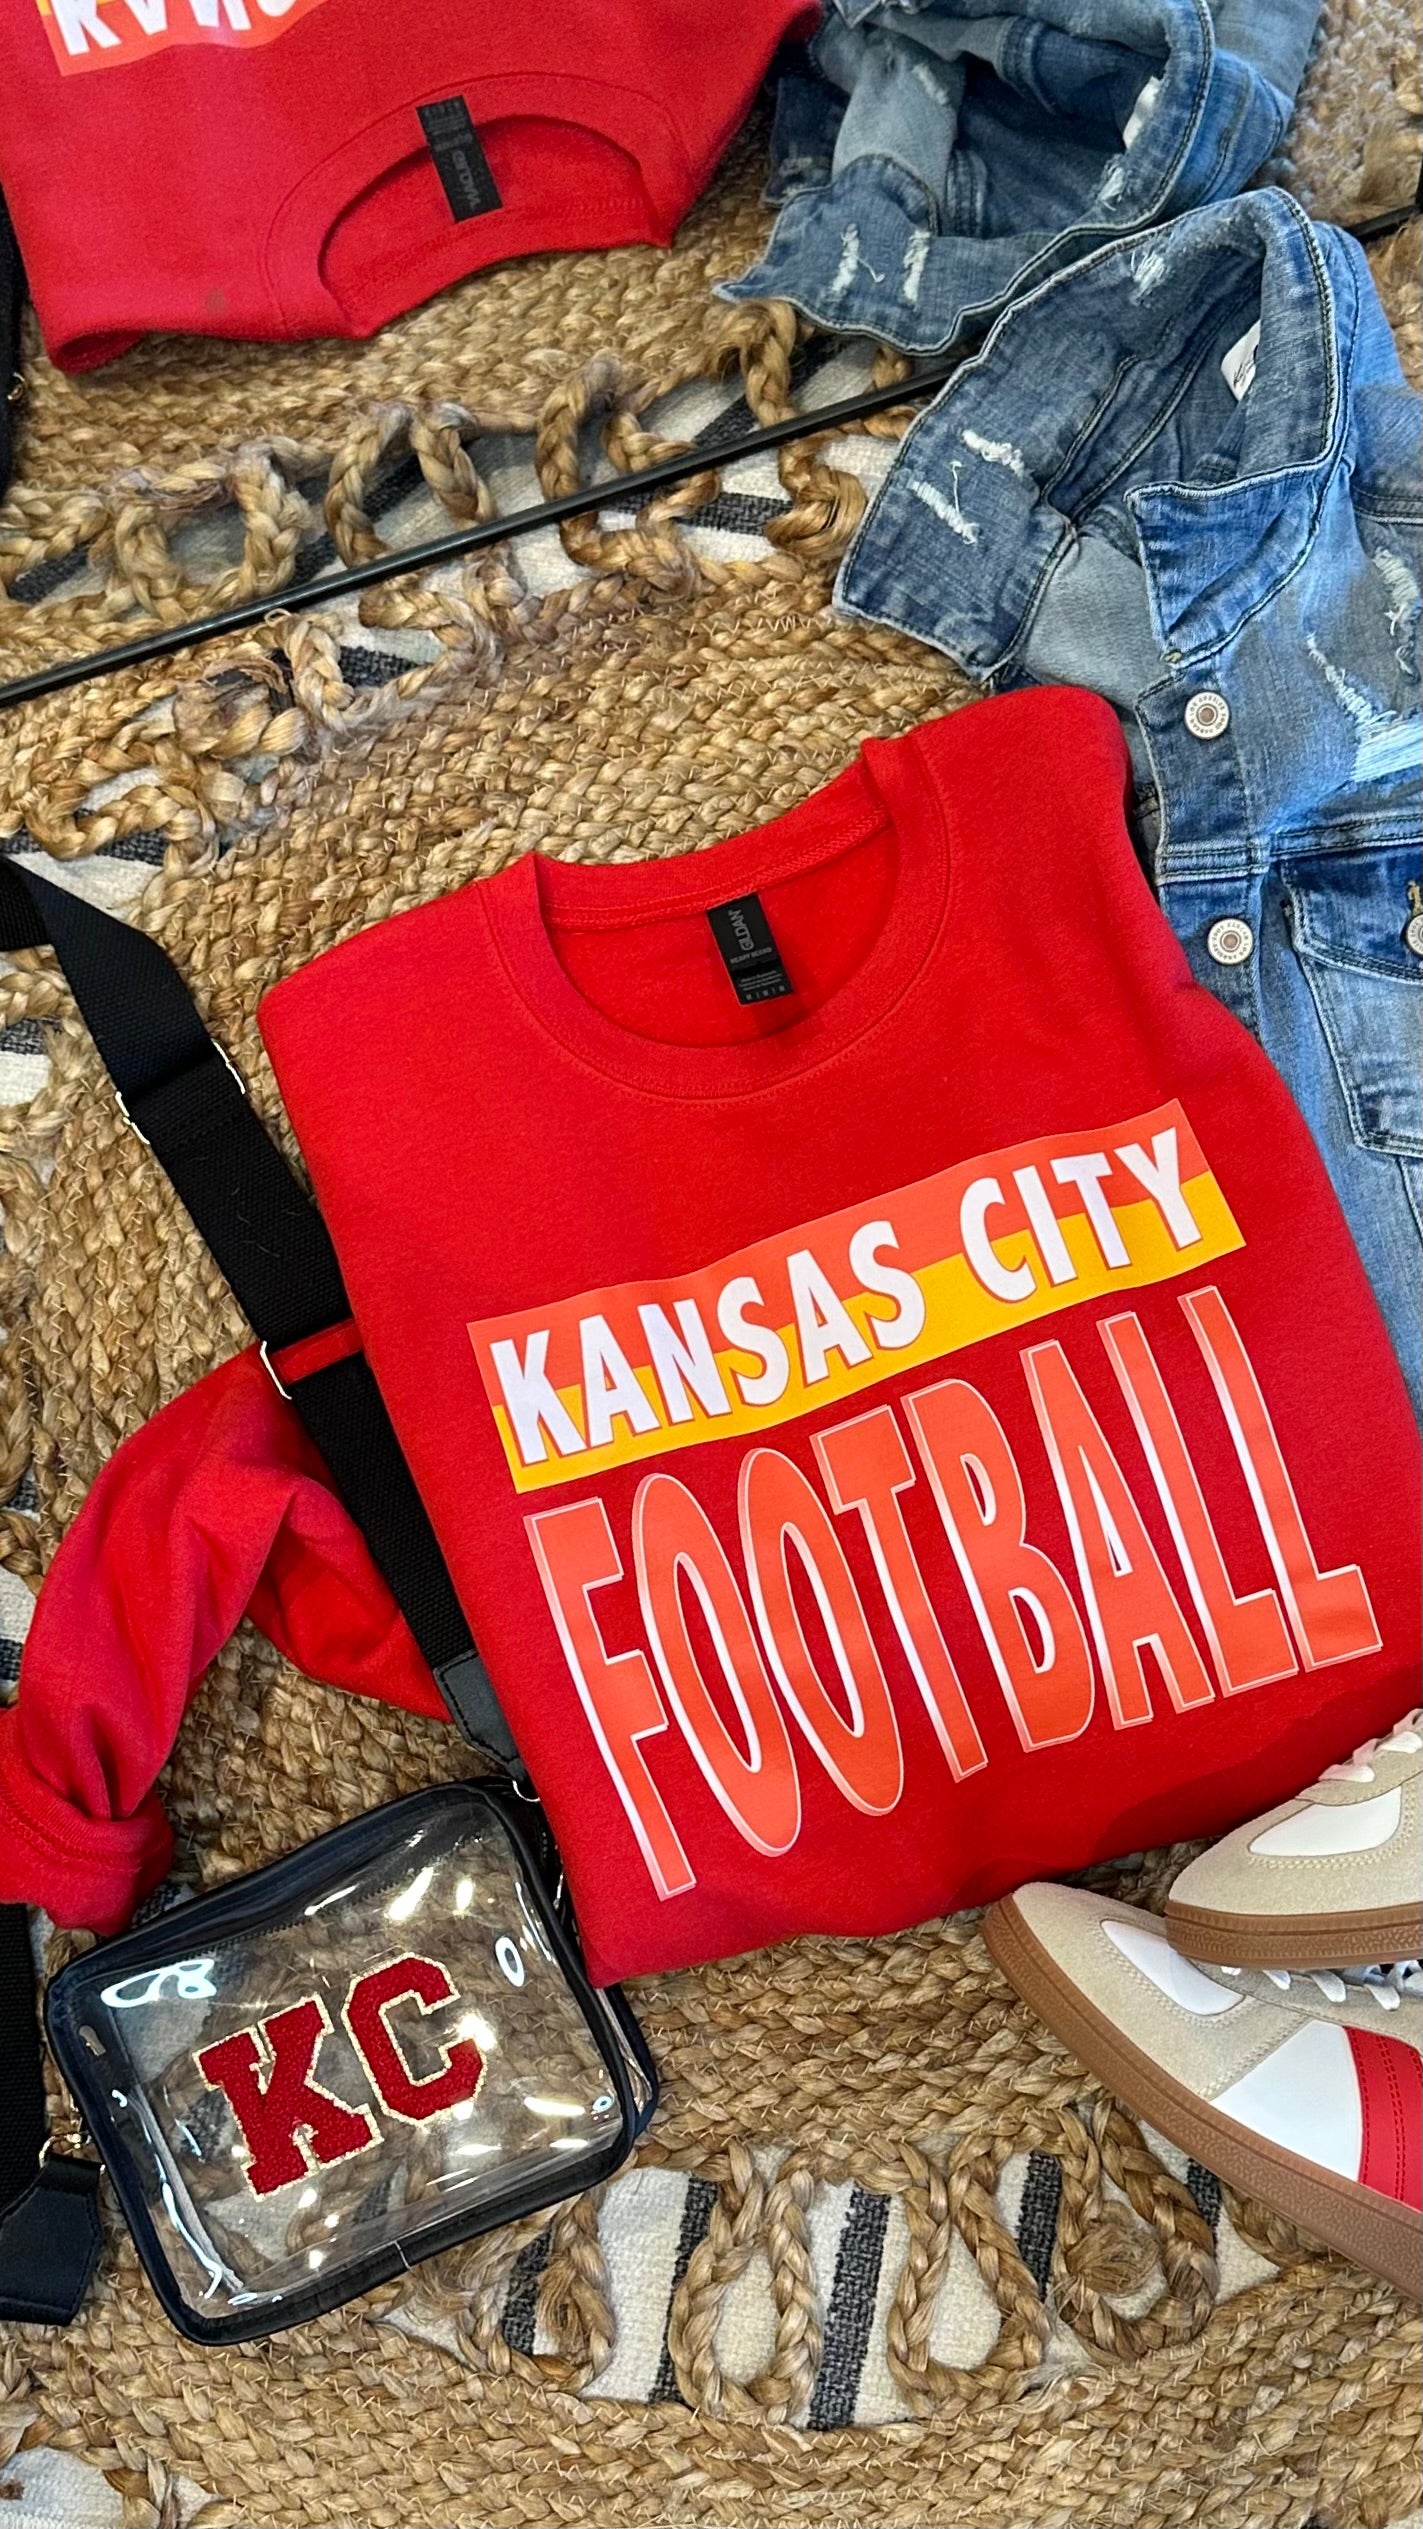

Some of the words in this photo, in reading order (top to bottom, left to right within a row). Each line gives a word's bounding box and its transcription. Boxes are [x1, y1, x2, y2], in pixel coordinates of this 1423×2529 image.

[728, 909, 755, 951] GILDAN
[489, 1219, 927, 1466] KANSAS
[959, 1126, 1202, 1303] CITY
[523, 1285, 1383, 1902] FOOTBALL
[193, 1952, 487, 2202] KC
